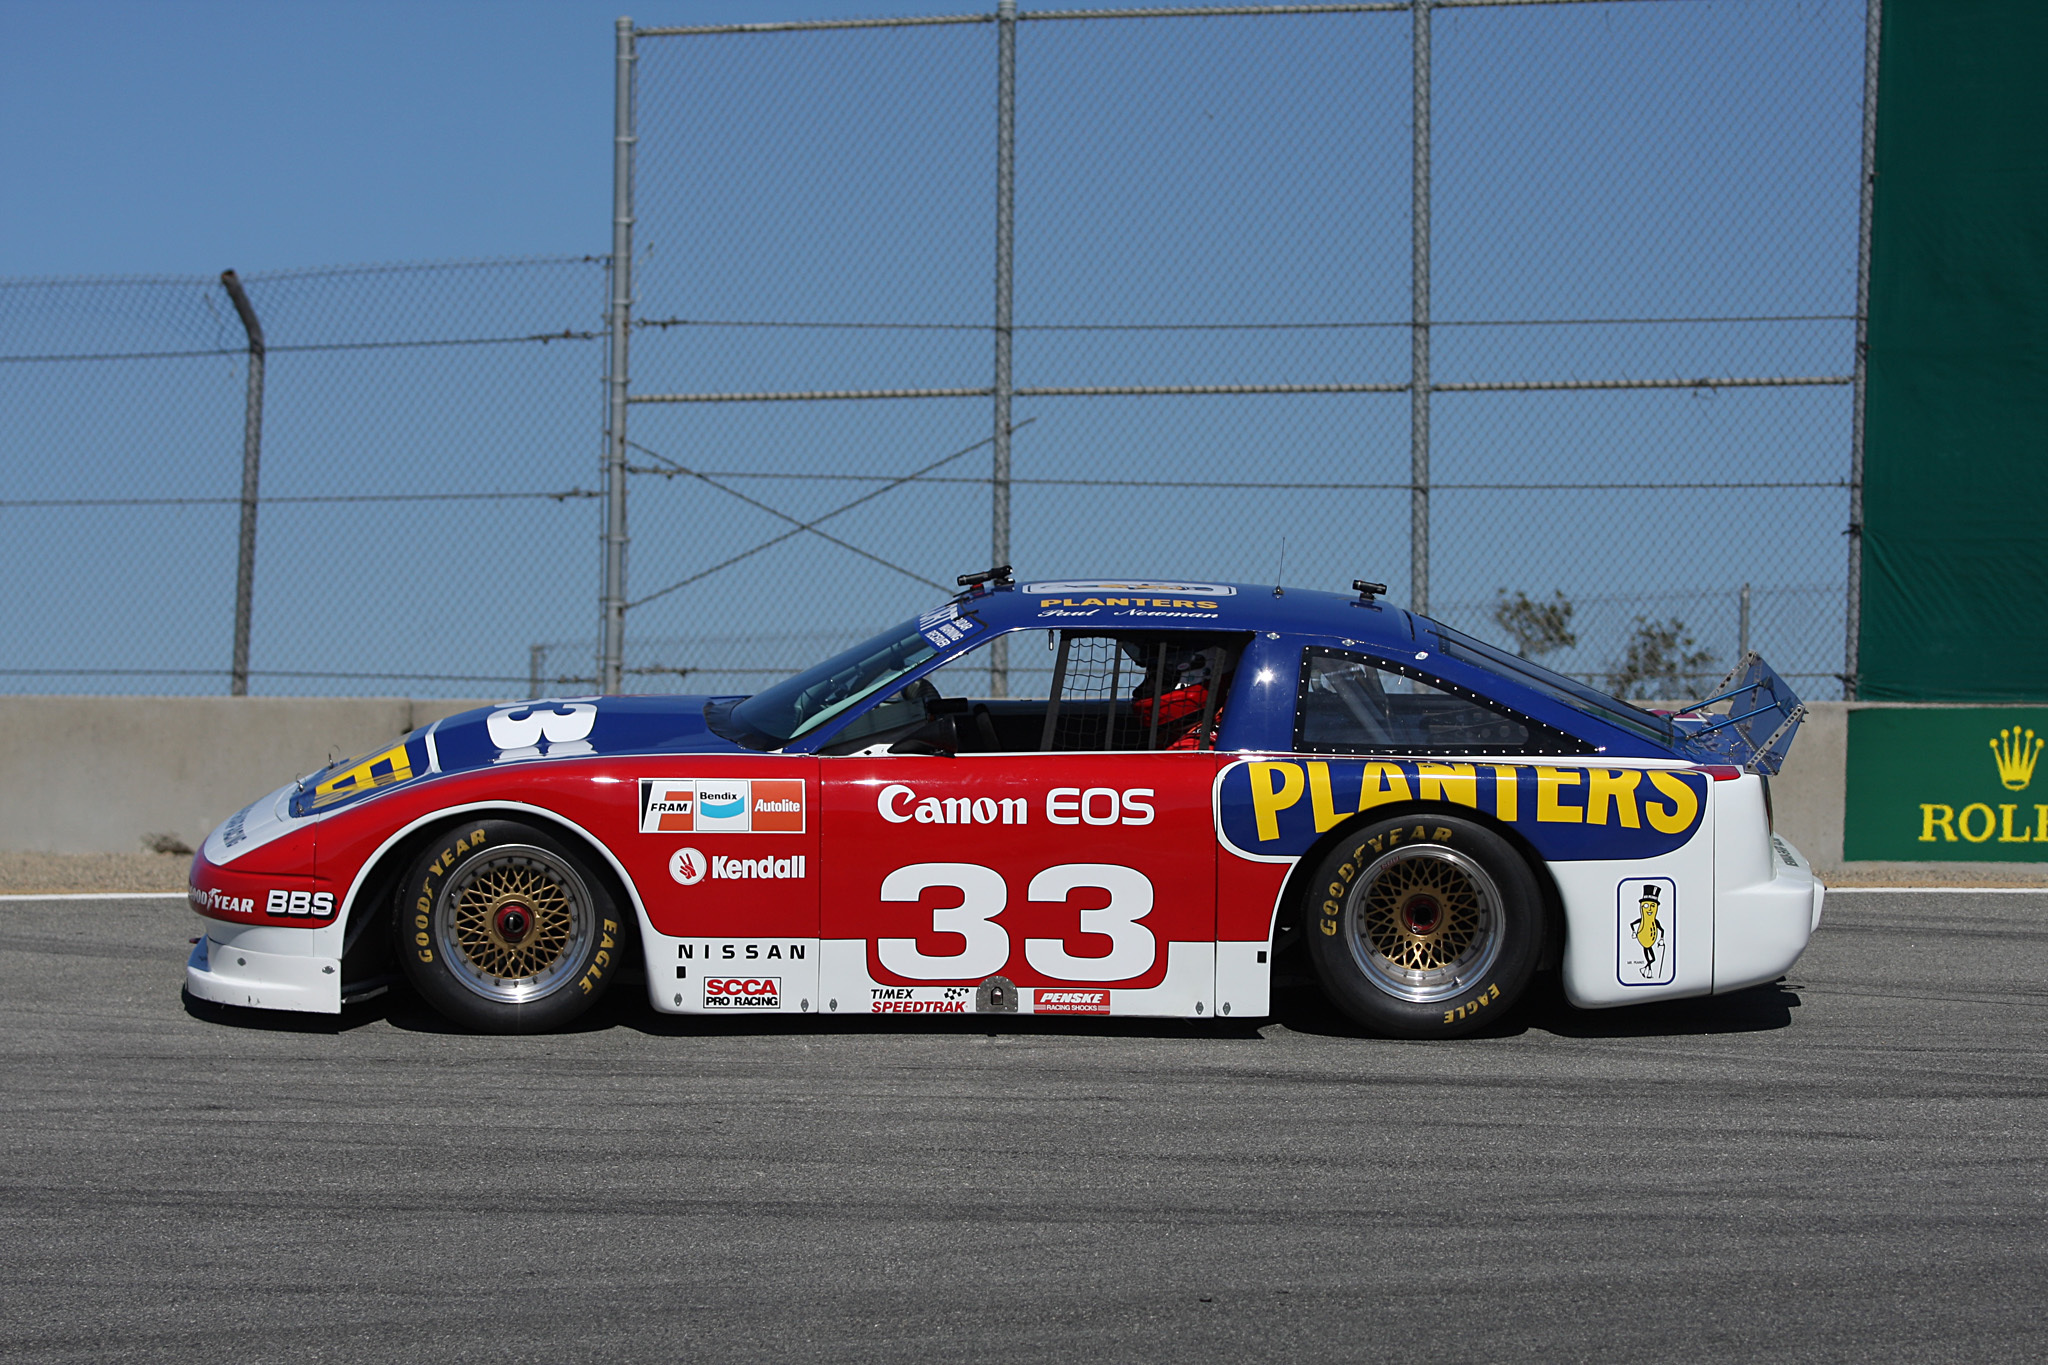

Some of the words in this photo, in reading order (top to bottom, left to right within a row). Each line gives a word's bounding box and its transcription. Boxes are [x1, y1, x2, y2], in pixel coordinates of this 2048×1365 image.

[1040, 598, 1219, 609] PLANTERS
[1037, 608, 1101, 618] Paul
[1113, 608, 1219, 619] Newman
[700, 792, 737, 800] Bendix
[1248, 761, 1699, 842] PLANTERS
[650, 803, 688, 812] FRAM
[754, 799, 801, 812] Autolite
[877, 784, 1028, 825] Canon
[1046, 787, 1155, 826] EOS
[712, 855, 806, 880] Kendall
[266, 889, 334, 916] BBS
[877, 862, 1156, 982] 33
[579, 918, 618, 995] EAGLE
[678, 944, 806, 960] NISSAN
[706, 979, 778, 996] SCCA
[871, 989, 914, 999] TIMEX
[706, 997, 730, 1006] PRO
[734, 997, 778, 1006] RACING
[1040, 992, 1104, 1003] PENSKE
[1443, 983, 1501, 1024] EAGLE
[871, 1001, 966, 1013] SPEEDTRAK
